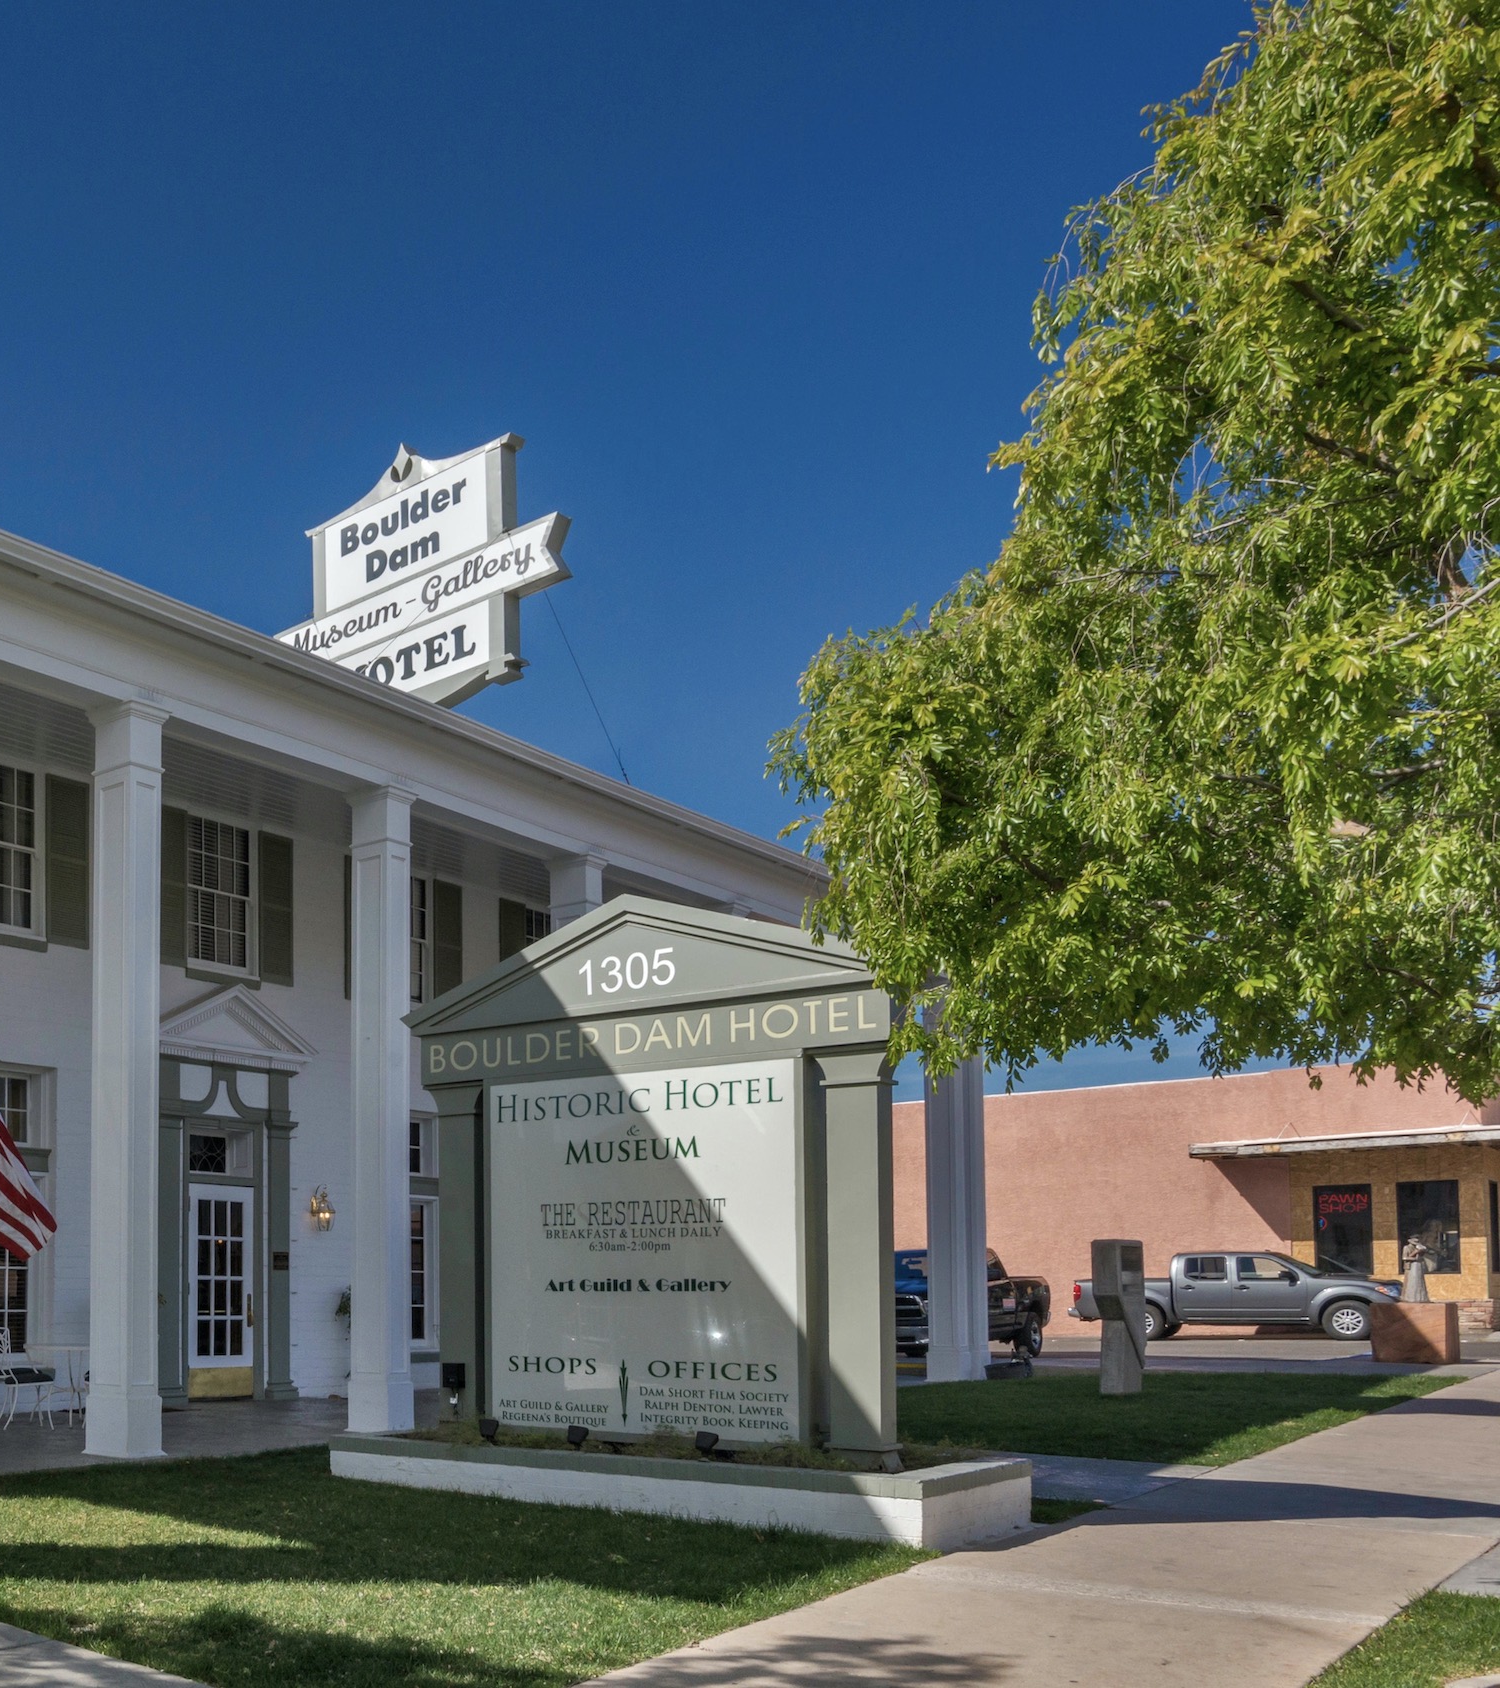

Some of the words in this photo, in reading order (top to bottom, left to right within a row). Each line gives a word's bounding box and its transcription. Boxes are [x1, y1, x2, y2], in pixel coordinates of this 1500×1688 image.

[340, 477, 467, 557] Boulder
[365, 531, 440, 583] Dam
[293, 601, 402, 653] Museum
[421, 542, 535, 613] Gallery
[356, 624, 476, 686] OTEL
[578, 946, 677, 996] 1305
[429, 1026, 600, 1075] BOULDER
[614, 1011, 712, 1056] DAM
[729, 994, 877, 1043] HOTEL
[496, 1087, 651, 1124] HISTORIC
[663, 1076, 784, 1111] HOTEL
[626, 1124, 640, 1137] &
[564, 1134, 701, 1166] MUSEUM
[1318, 1194, 1368, 1203] PAWN
[1319, 1203, 1368, 1213] SHOP
[541, 1203, 576, 1227] THE
[587, 1197, 726, 1226] RESTAURANT
[545, 1228, 617, 1240] BREAKFAST
[619, 1228, 628, 1239] &
[632, 1227, 676, 1239] LUNCH
[680, 1226, 722, 1237] DAILY
[589, 1241, 671, 1253] 6:30am-2:00pm
[545, 1279, 575, 1292] Art
[579, 1278, 632, 1292] Guild
[636, 1278, 650, 1292] &
[655, 1278, 732, 1292] Gallery
[508, 1355, 597, 1375] SHOPS
[647, 1360, 778, 1383] OFFICES
[639, 1386, 664, 1397] DAM
[668, 1387, 705, 1399] SHORT
[709, 1389, 736, 1400] FILM
[739, 1391, 789, 1403] SOCIETY
[499, 1399, 517, 1408] ART
[520, 1399, 552, 1411] GUILD
[554, 1401, 563, 1411] &
[565, 1401, 609, 1413] GALLERY
[644, 1399, 679, 1411] RALPH
[683, 1401, 735, 1414] DENTON,
[739, 1404, 784, 1416] LAWYER
[502, 1410, 551, 1423] REGEENA'S
[554, 1414, 607, 1427] BOUTIQUE
[640, 1412, 699, 1425] INTEGRITY
[702, 1417, 735, 1428] BOOK
[738, 1418, 789, 1431] KEEPING
